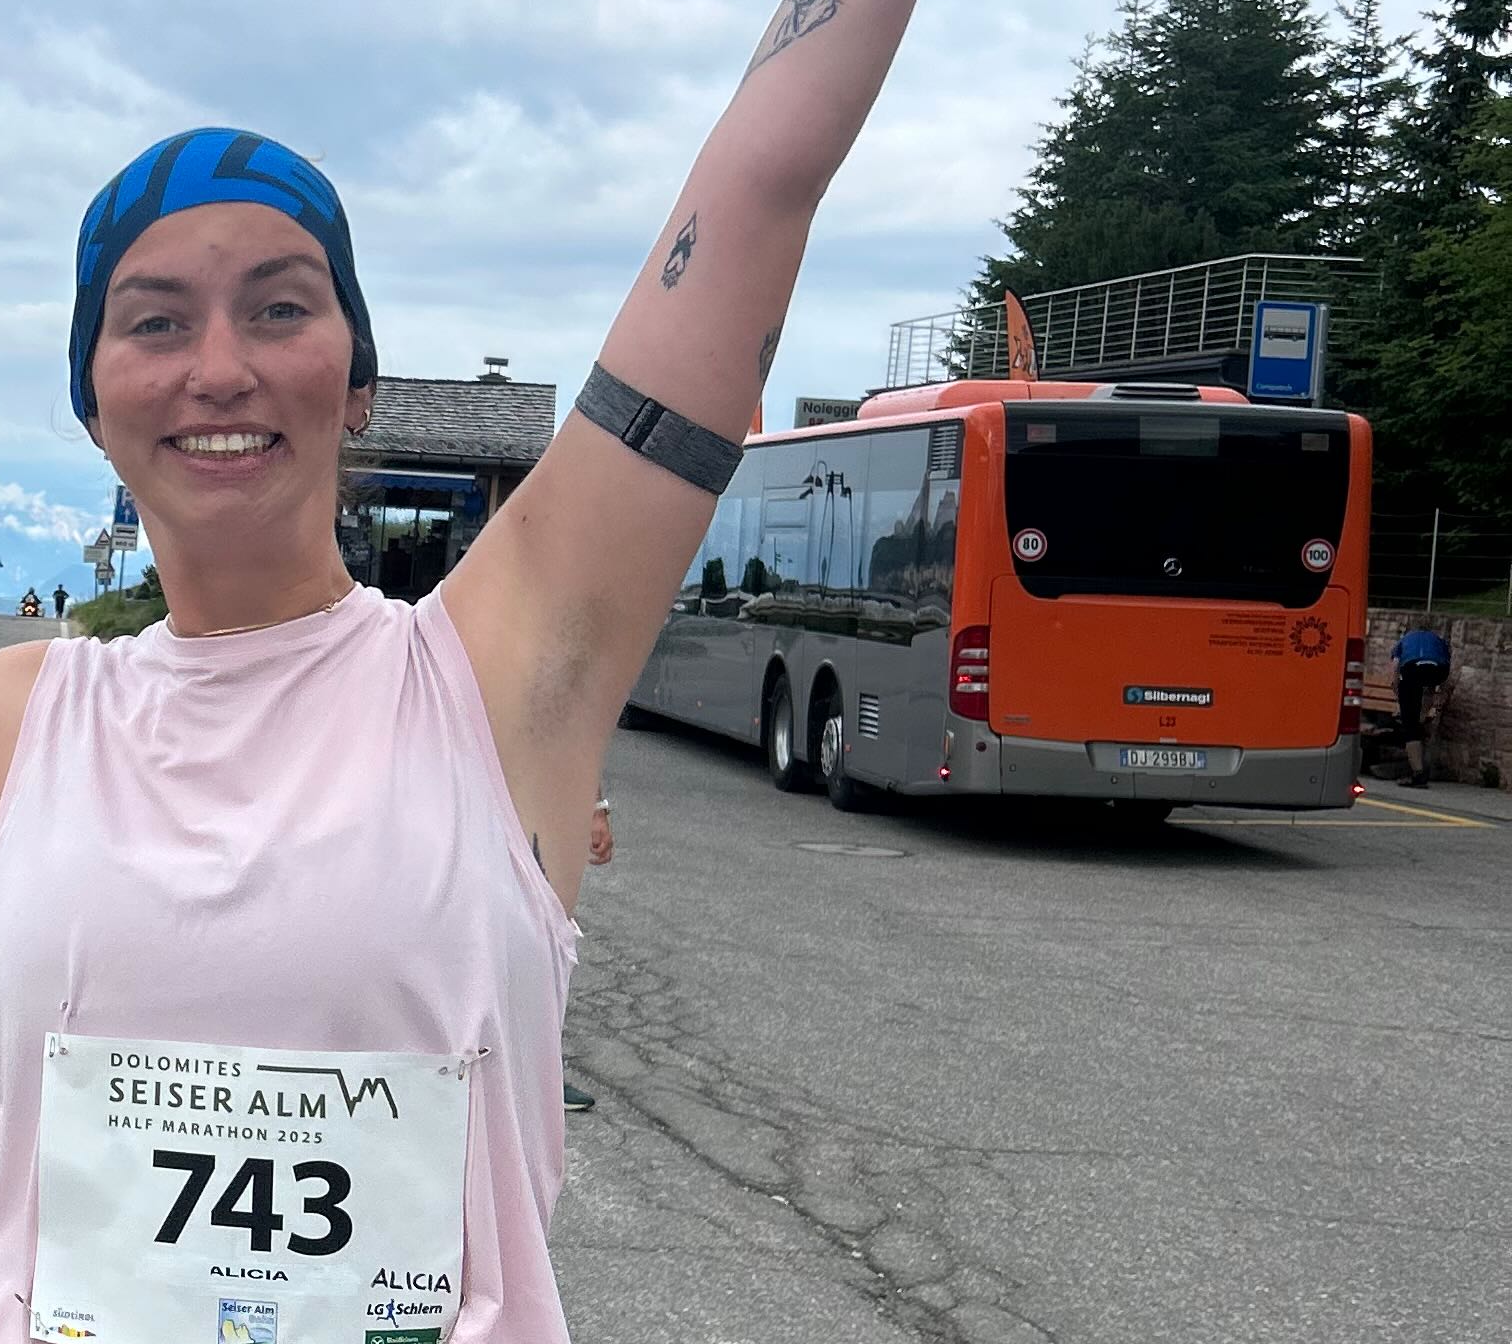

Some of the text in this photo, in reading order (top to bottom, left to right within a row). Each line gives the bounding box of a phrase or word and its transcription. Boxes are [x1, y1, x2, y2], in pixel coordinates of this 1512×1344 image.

[1023, 538, 1039, 551] 80
[1309, 550, 1329, 561] 100
[1144, 690, 1211, 704] Silbernagl
[110, 1052, 242, 1078] DOLOMITES
[108, 1077, 327, 1119] SEISER ALM
[108, 1115, 324, 1145] HALF MARATHON 2025
[152, 1149, 354, 1257] 743
[209, 1265, 290, 1282] ALICIA
[370, 1267, 452, 1294] ALICIA
[221, 1301, 275, 1316] Seiser Alm
[366, 1302, 443, 1316] LG Schlern
